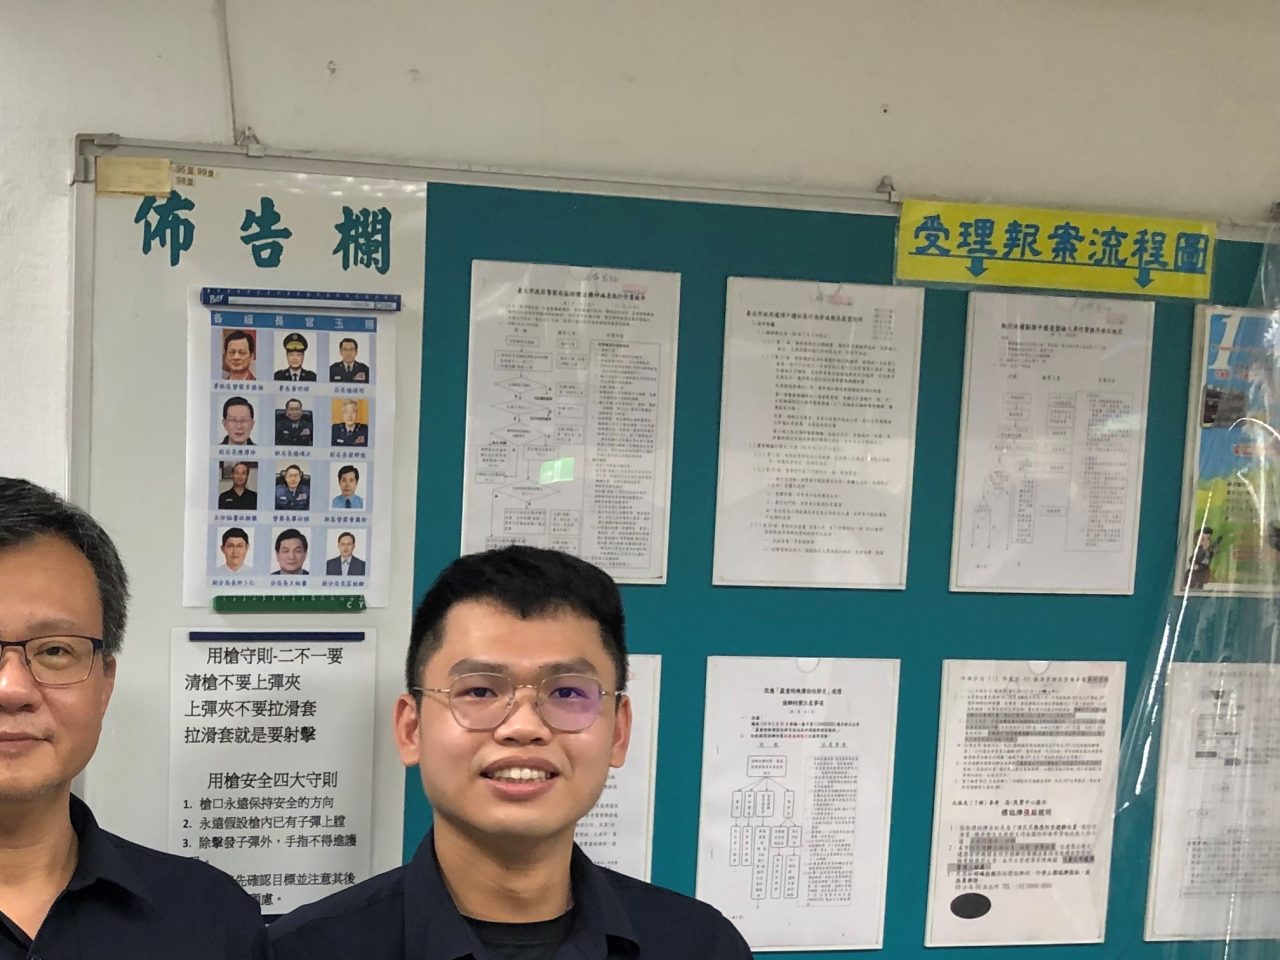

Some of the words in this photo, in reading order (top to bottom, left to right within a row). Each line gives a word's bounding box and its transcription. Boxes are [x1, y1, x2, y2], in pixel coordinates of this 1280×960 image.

[134, 190, 392, 275] 佈告欄
[914, 214, 1209, 273] 受理報案流程圖
[206, 647, 343, 665] 用槍守則-二不一要
[184, 674, 300, 691] 清槍不要上彈夾
[184, 700, 317, 717] 上彈夾不要拉滑套
[184, 726, 316, 743] 拉滑套就是要射擊
[207, 771, 338, 790] 用槍安全四大守則
[183, 799, 192, 809] 1.
[200, 796, 334, 811] 槍口永遠保持安全的方向
[182, 819, 192, 829] 2.
[182, 839, 192, 848] 3.
[231, 872, 356, 887] 先確認目標並注意其後
